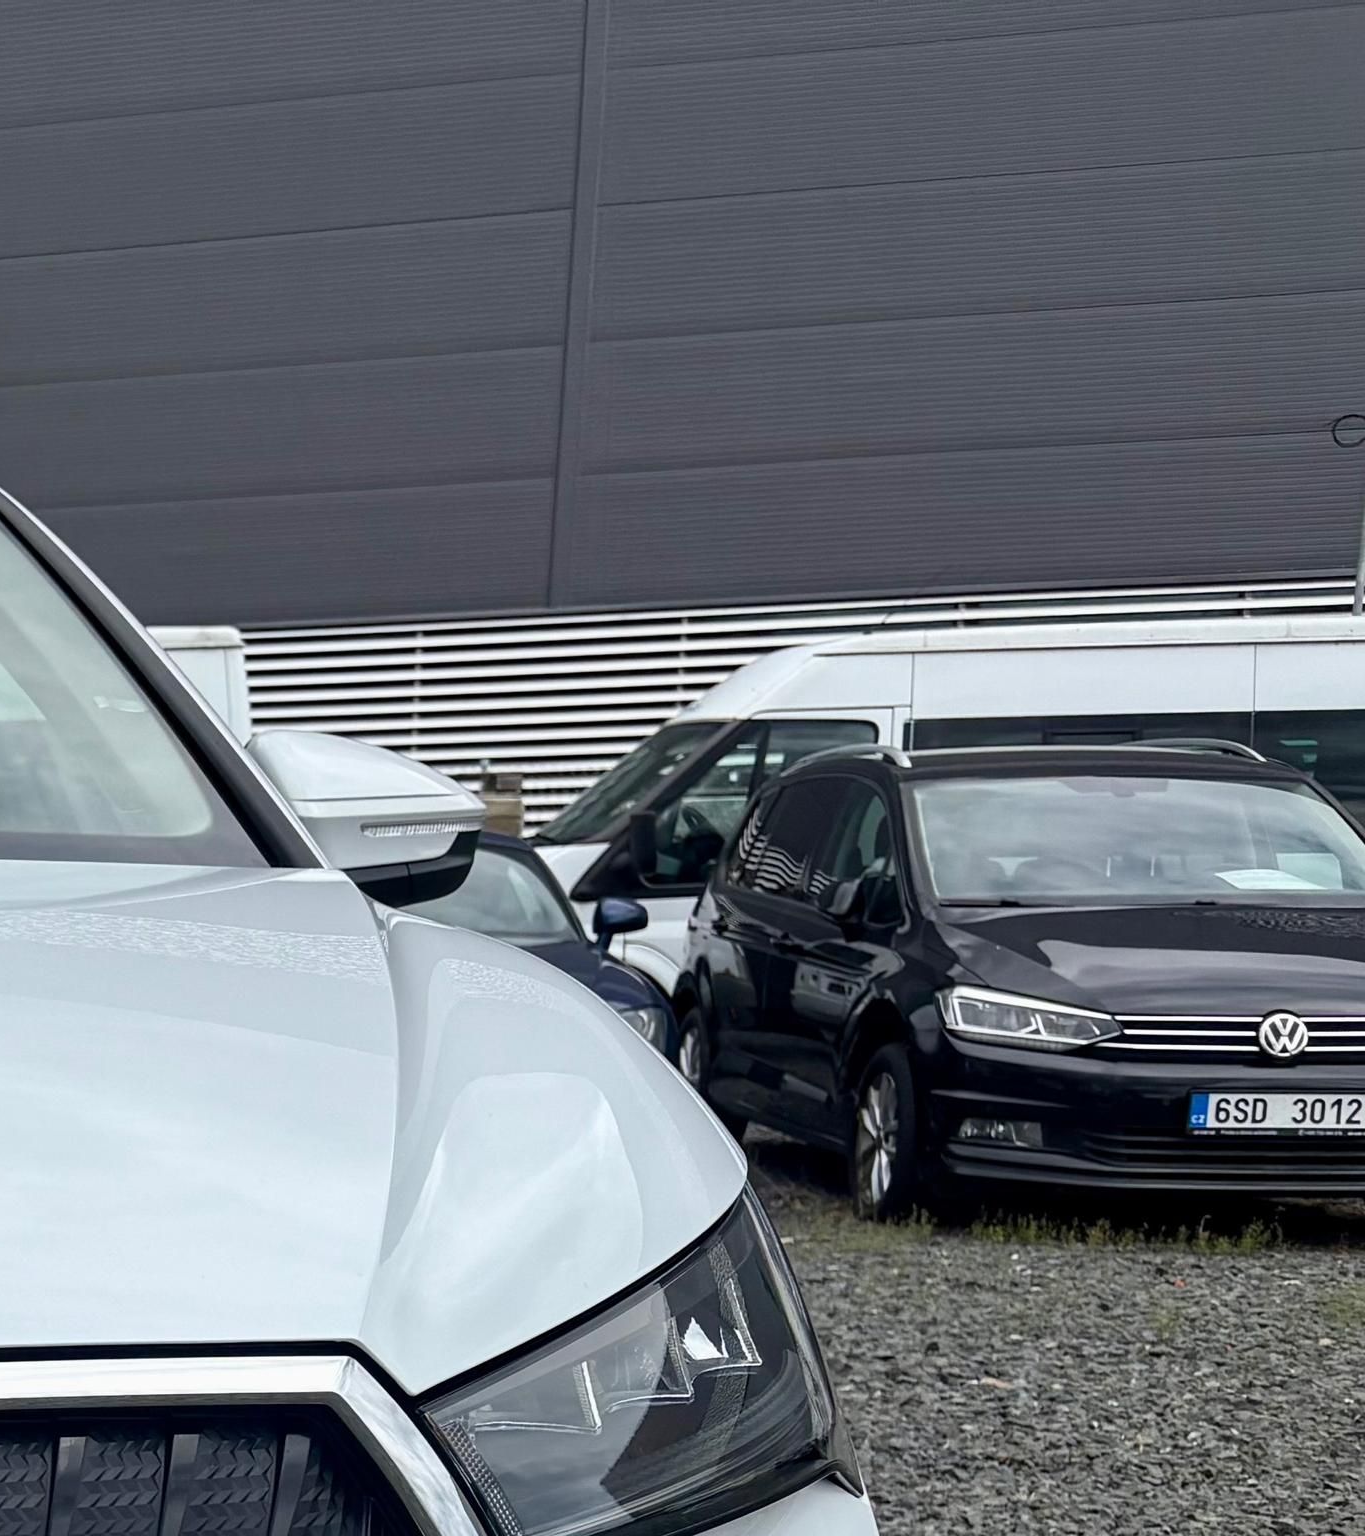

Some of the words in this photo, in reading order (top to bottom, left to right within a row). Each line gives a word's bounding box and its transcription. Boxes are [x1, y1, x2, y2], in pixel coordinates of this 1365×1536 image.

[1190, 1114, 1206, 1124] CZ
[1214, 1097, 1268, 1124] 6SD
[1291, 1098, 1363, 1125] 3012
